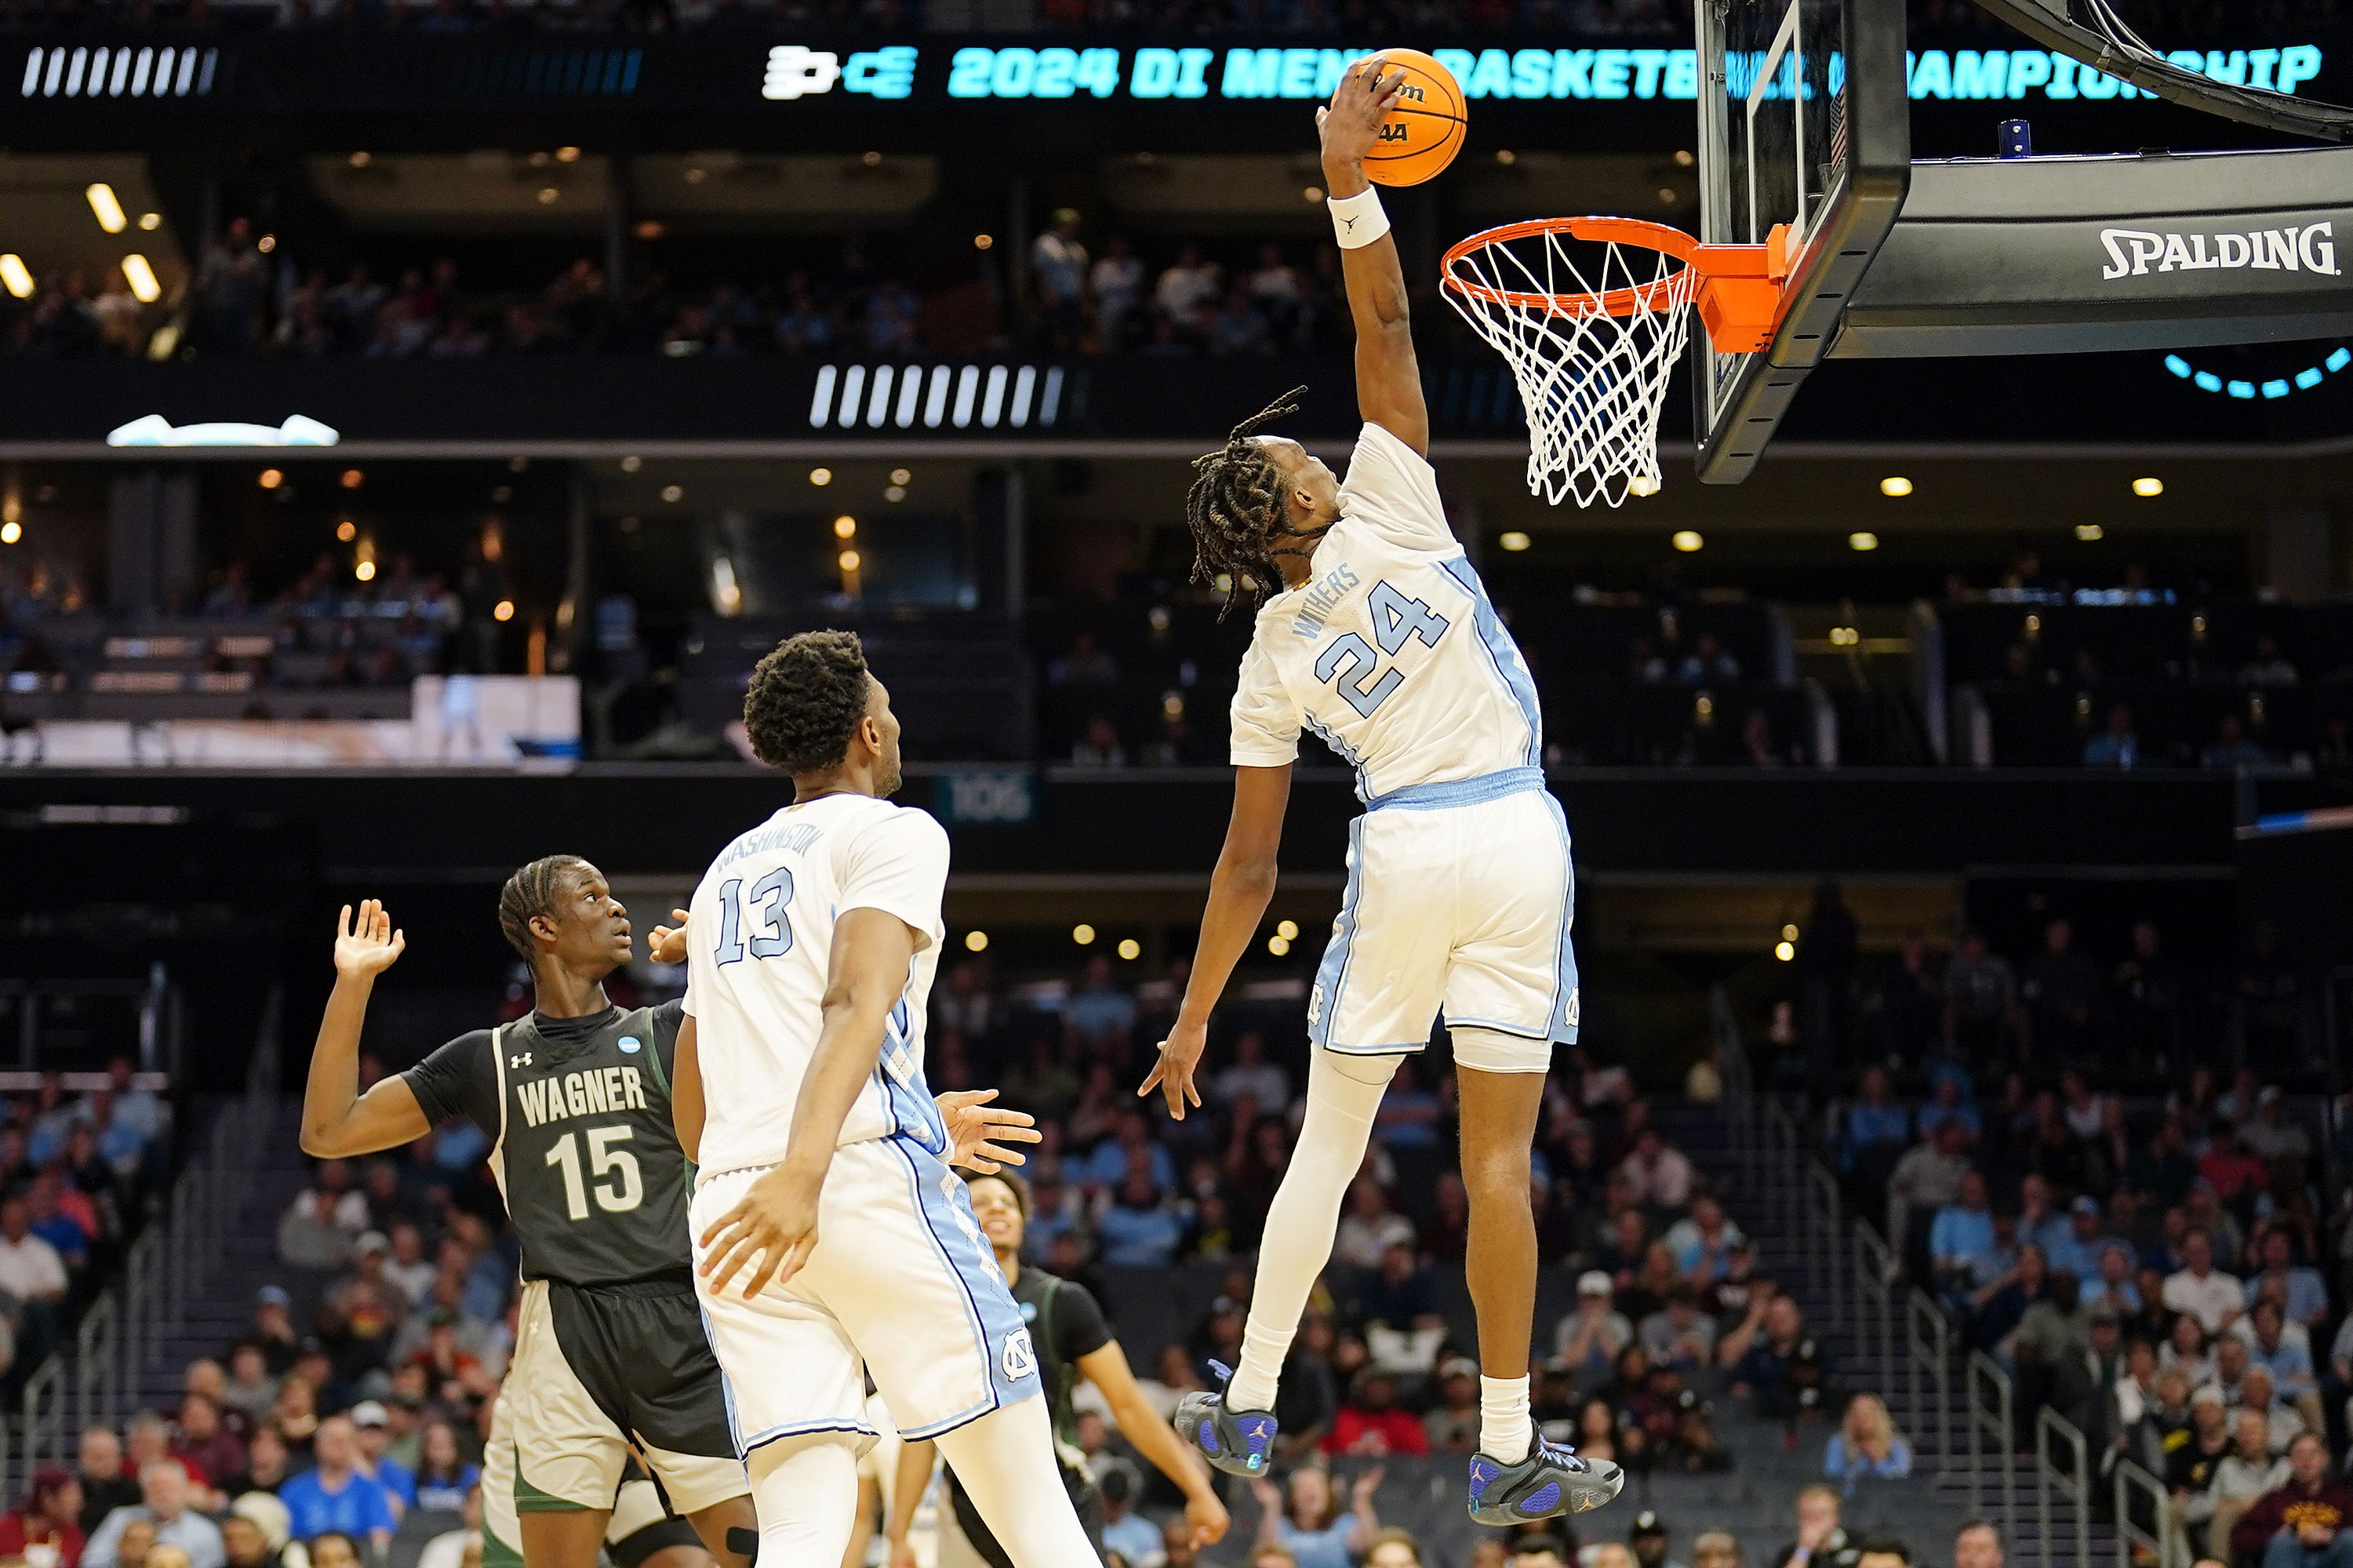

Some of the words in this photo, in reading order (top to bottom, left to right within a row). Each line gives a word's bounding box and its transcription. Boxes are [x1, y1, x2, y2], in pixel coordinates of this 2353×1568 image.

[947, 48, 1120, 98] 2024
[1129, 48, 1214, 98] DI
[1220, 48, 1375, 99] MEN
[2100, 221, 2335, 280] SPALDING
[1293, 562, 1360, 639] WITHERS
[1315, 580, 1450, 719] 24
[715, 867, 794, 970] 13
[517, 1066, 647, 1128] WAGNER
[546, 1125, 644, 1221] 15
